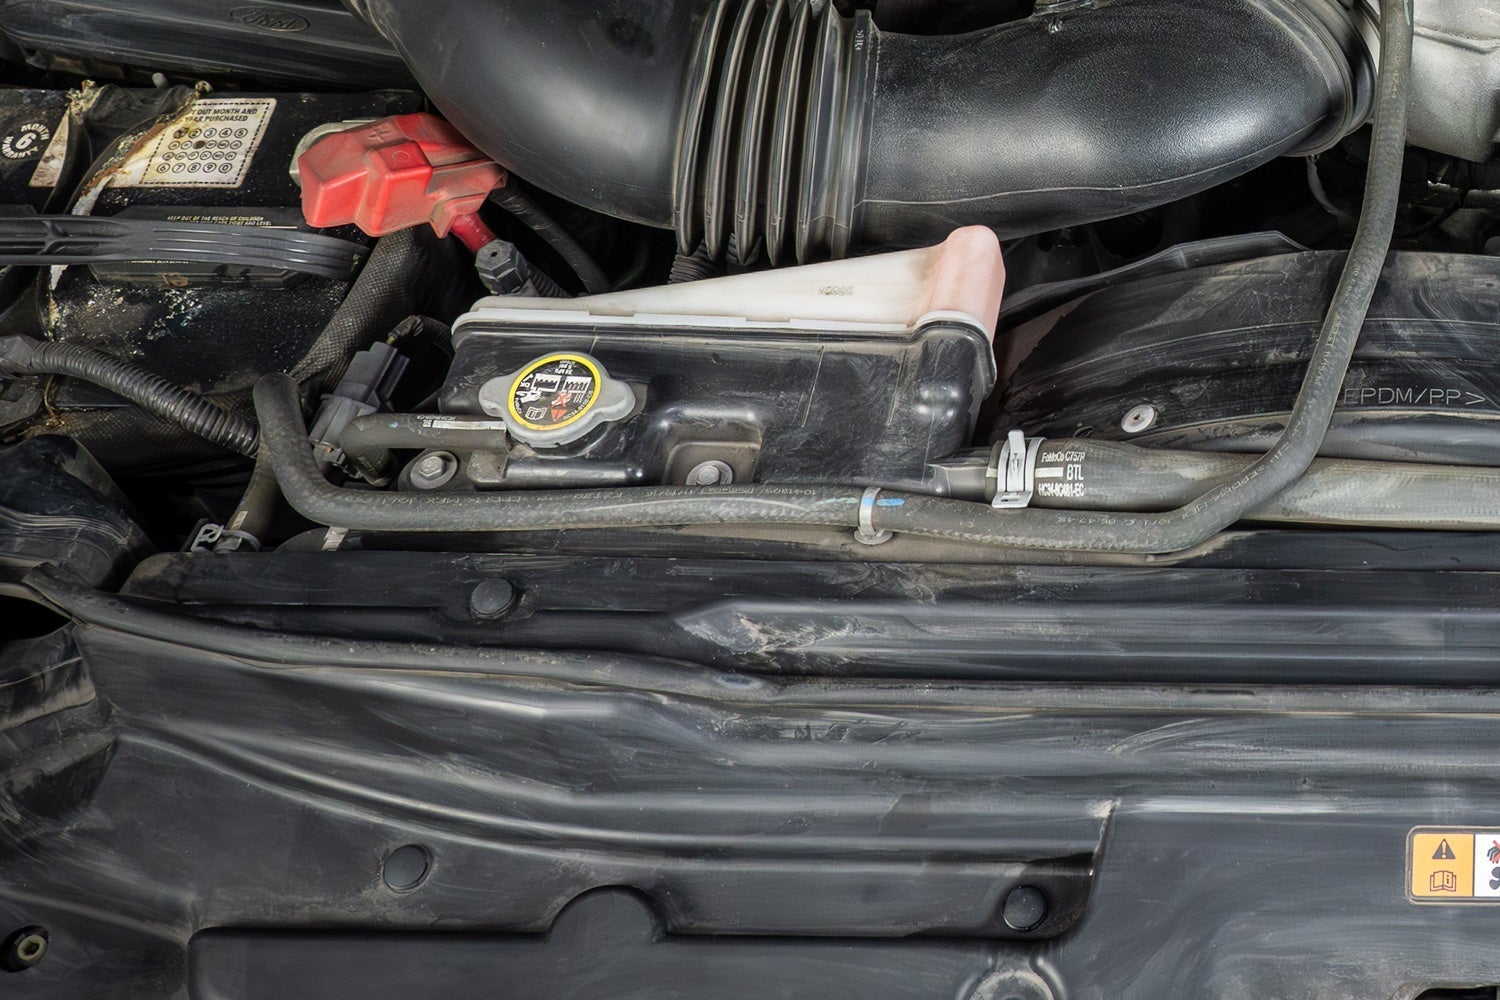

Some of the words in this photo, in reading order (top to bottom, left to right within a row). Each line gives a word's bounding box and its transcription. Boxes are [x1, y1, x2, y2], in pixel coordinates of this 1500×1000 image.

[20, 122, 50, 140] MONTH
[15, 132, 37, 150] 6
[1066, 464, 1084, 480] BTL
